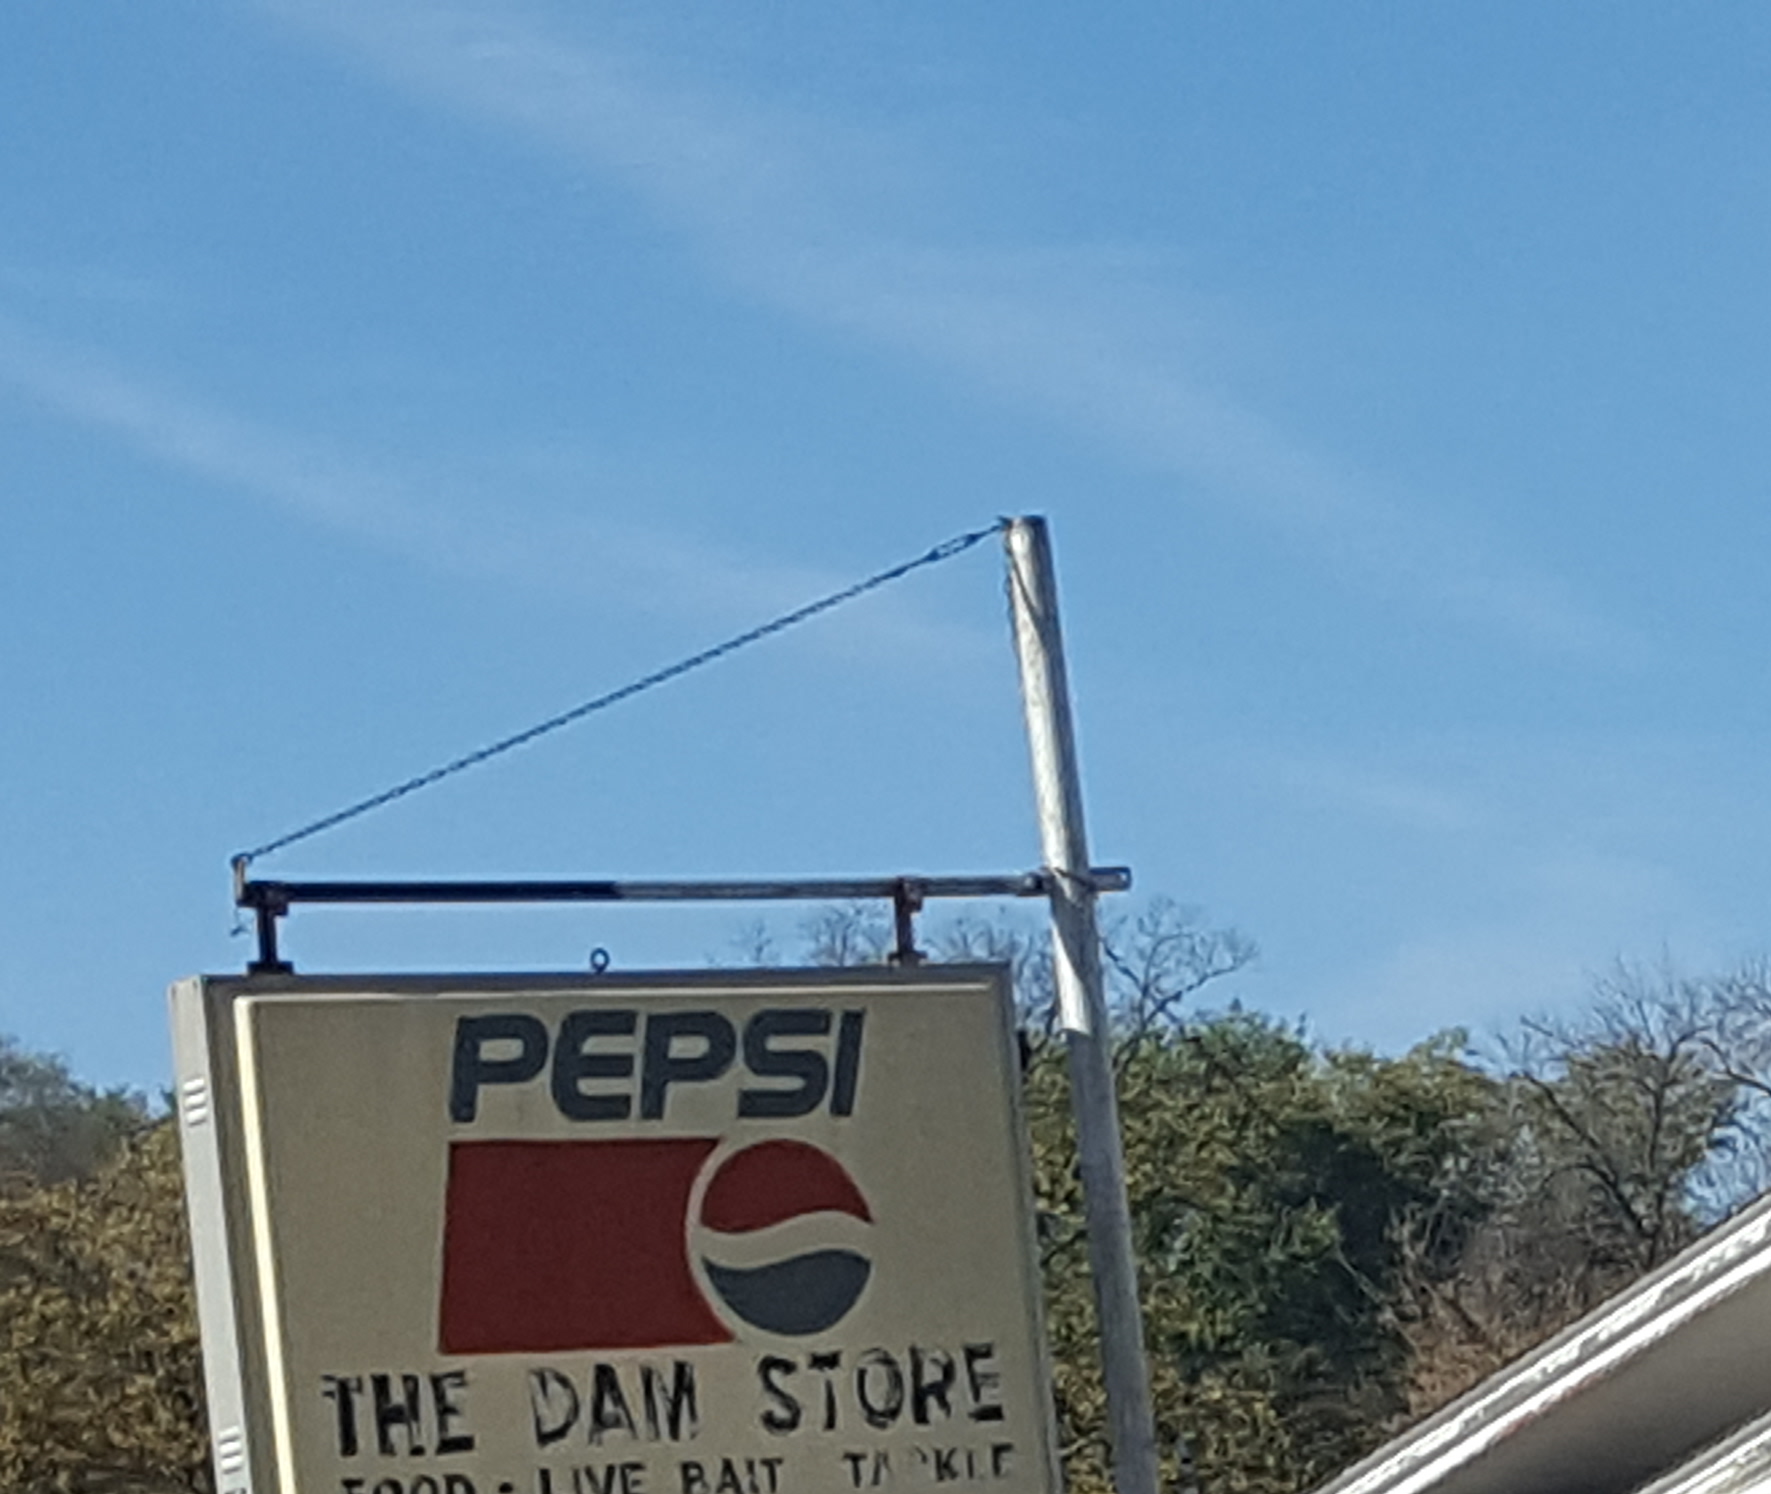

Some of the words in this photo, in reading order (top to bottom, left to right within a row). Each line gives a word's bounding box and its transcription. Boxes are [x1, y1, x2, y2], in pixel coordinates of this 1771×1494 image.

[448, 1008, 867, 1124] PEPSI
[320, 1369, 476, 1457] THE
[529, 1360, 700, 1447] DAM
[757, 1342, 1005, 1436] STORE
[842, 1443, 1015, 1489] TAKLE
